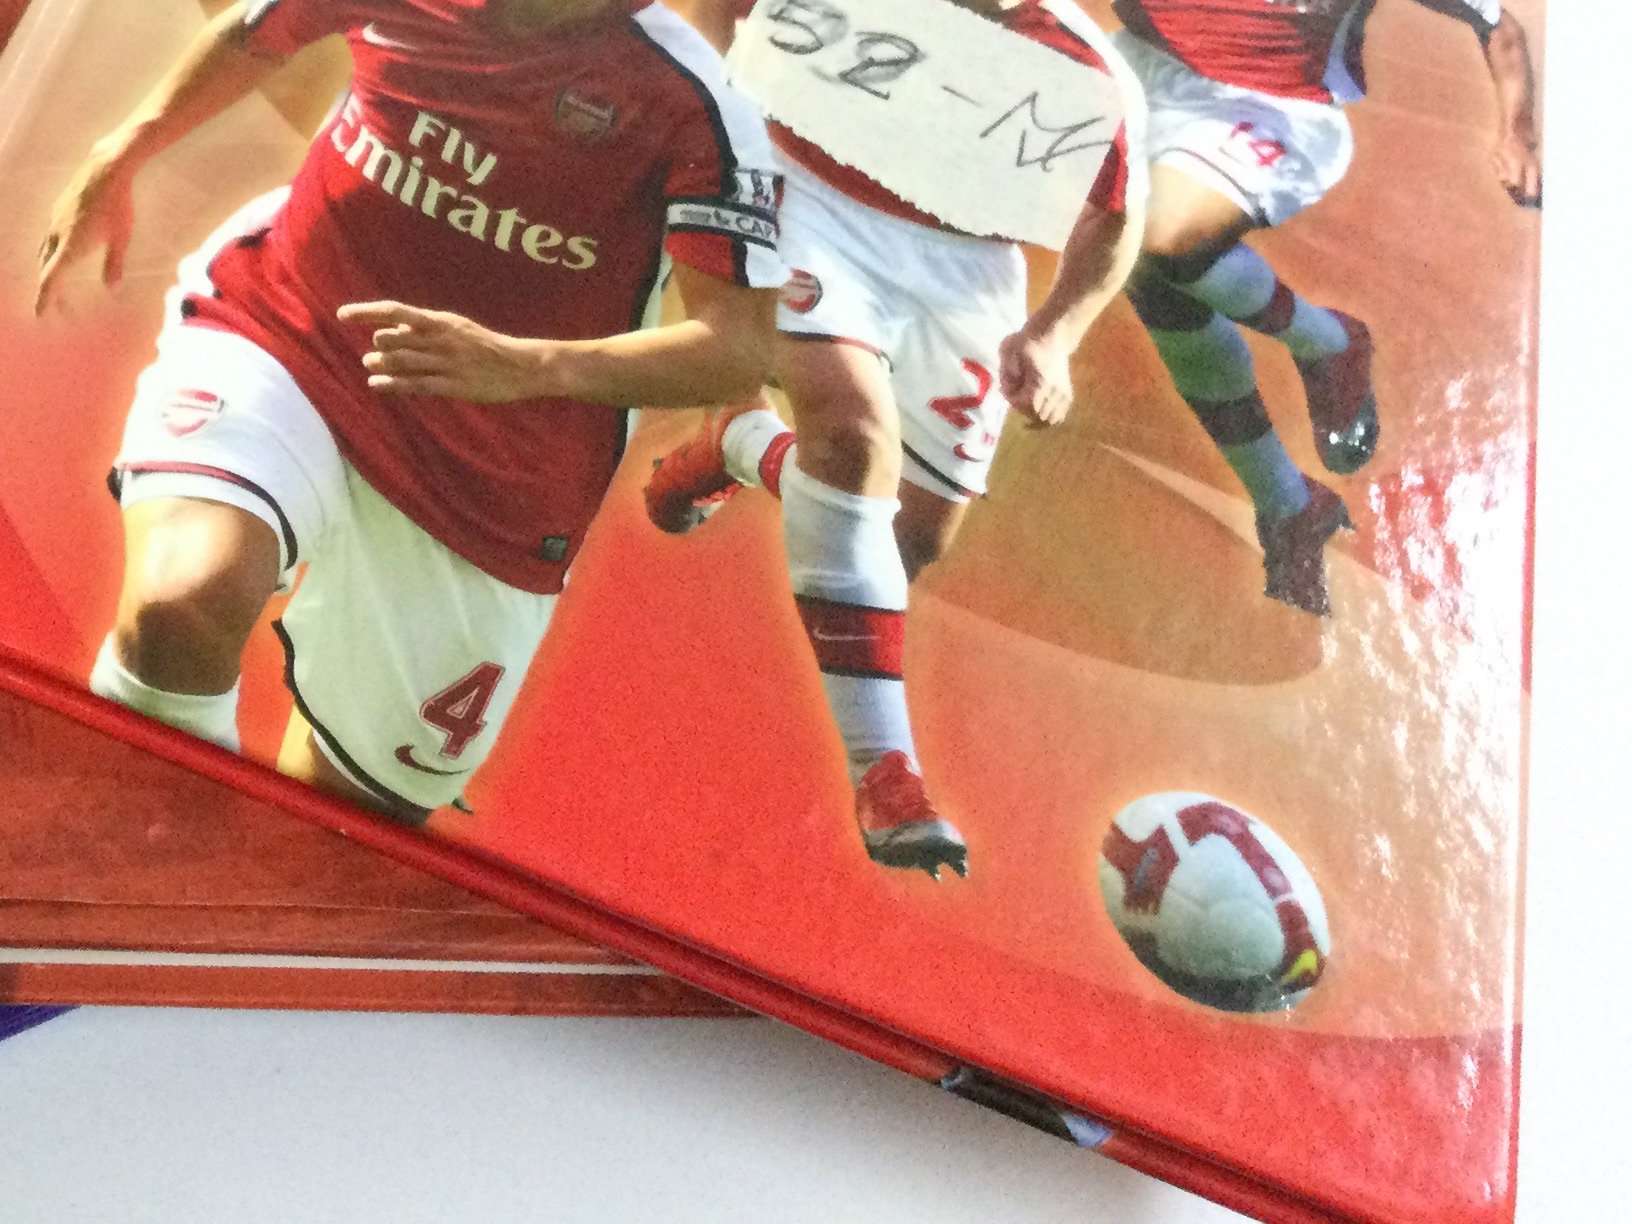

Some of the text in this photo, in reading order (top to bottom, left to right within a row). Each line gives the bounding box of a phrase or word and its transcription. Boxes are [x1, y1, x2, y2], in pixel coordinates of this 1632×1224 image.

[330, 91, 599, 270] Emirates
[409, 110, 497, 186] Fly
[420, 662, 505, 760] 4
